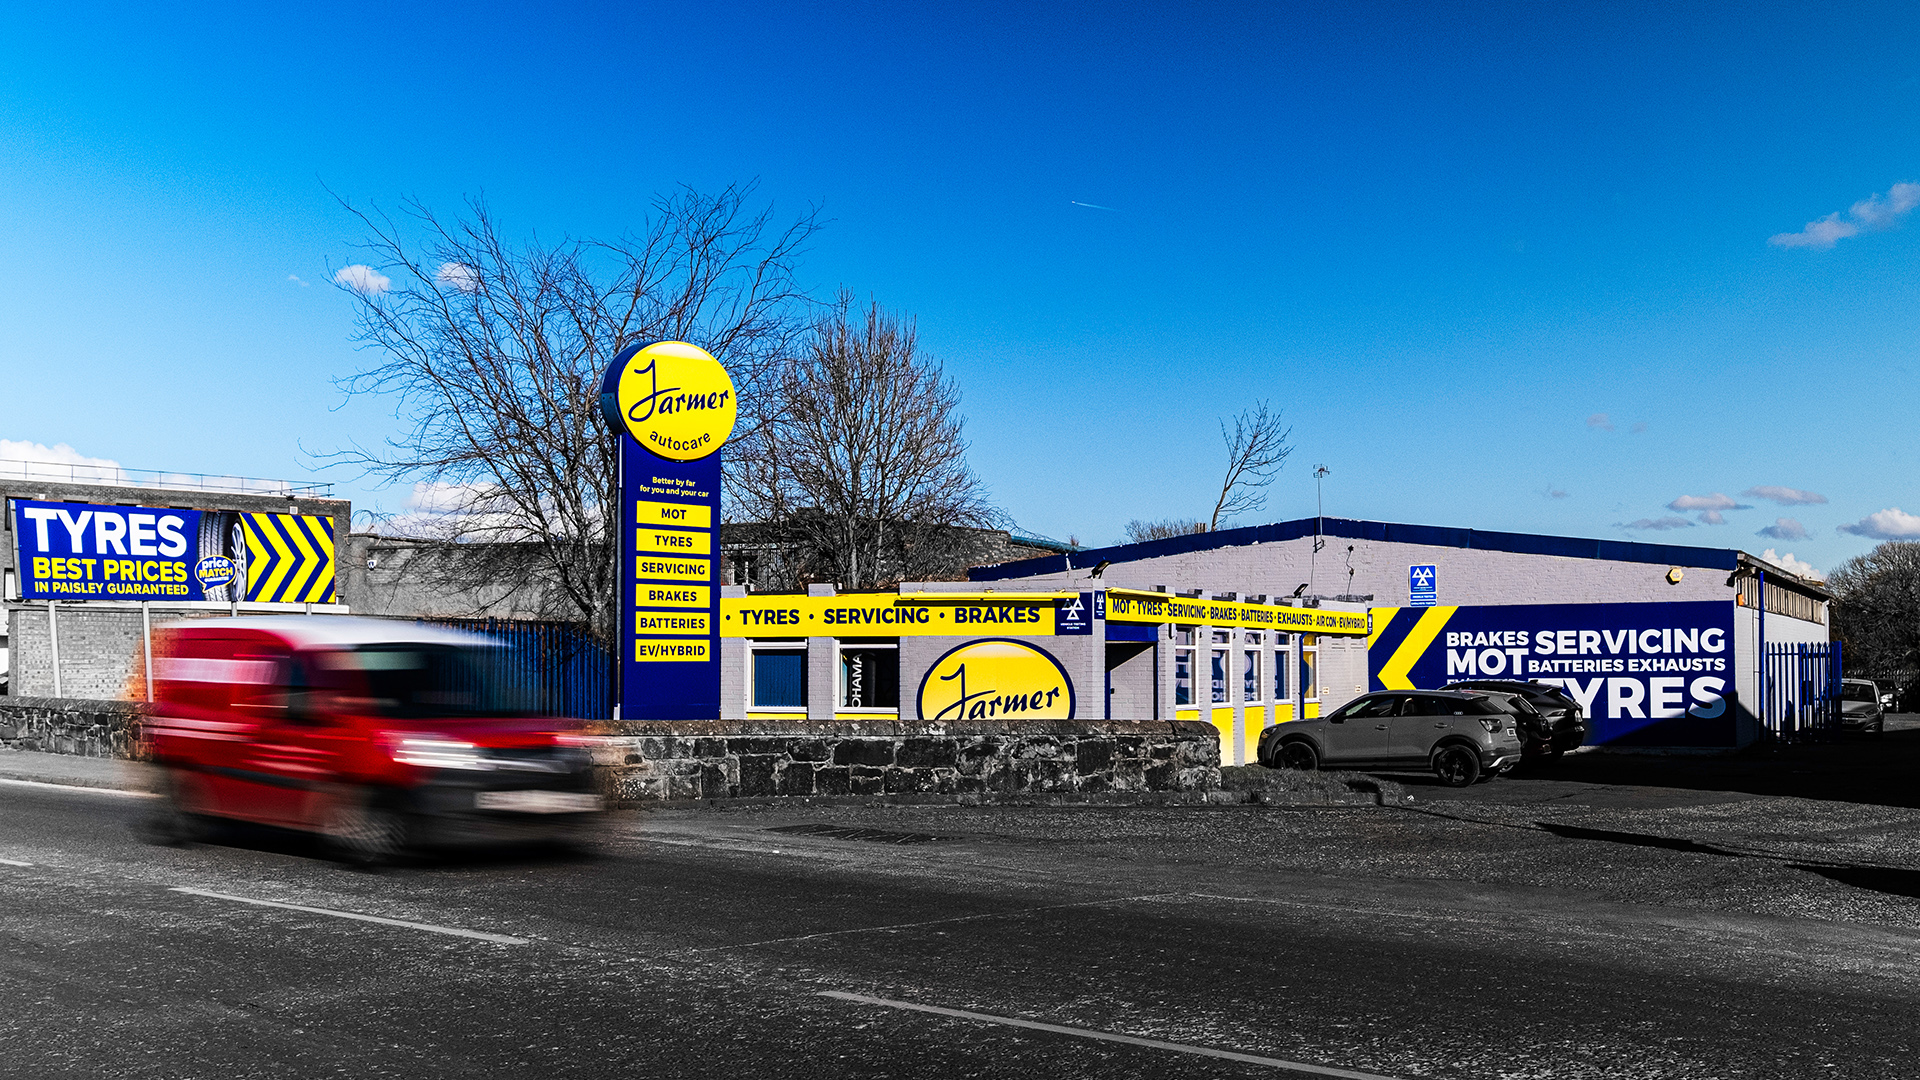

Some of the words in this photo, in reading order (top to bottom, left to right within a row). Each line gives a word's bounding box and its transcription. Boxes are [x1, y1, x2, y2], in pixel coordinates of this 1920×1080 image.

[649, 430, 711, 451] autocare
[652, 476, 674, 485] Better
[675, 478, 684, 487] by
[686, 479, 696, 487] far
[640, 484, 650, 492] for
[681, 489, 697, 497] your
[661, 508, 686, 520] MOT
[24, 507, 187, 557] TYRES
[654, 535, 693, 547] TYRES
[33, 557, 97, 580] BEST
[104, 560, 188, 582] PRICES
[202, 556, 229, 570] price
[641, 562, 705, 575] SERVICING
[199, 567, 233, 578] MATCH
[34, 582, 49, 593] IN
[52, 582, 104, 594] PAISLEY
[107, 583, 189, 596] GUARANTEED
[649, 590, 697, 602] BRAKES
[740, 609, 800, 625] TYRES
[823, 607, 930, 624] SERVICING
[954, 606, 1040, 623] BRAKES
[1113, 599, 1131, 614] MOT
[1136, 601, 1162, 616] TYRES
[1168, 603, 1206, 619] SERVICING
[1210, 606, 1237, 620] BRAKES
[1241, 608, 1273, 623] BATTERIES
[1277, 612, 1313, 626] EXHAUSTS
[1316, 615, 1325, 627] AIR
[1326, 616, 1337, 628] CON
[1339, 616, 1365, 629] EV/HYBRID
[640, 617, 705, 629] BATTERIES
[1447, 631, 1529, 647] BRAKES
[1534, 628, 1726, 655] SERVICING
[640, 644, 705, 657] EV/HYBRID
[1447, 648, 1530, 676] MOT
[1528, 659, 1625, 673] BATTERIES
[1628, 658, 1726, 672] EXHAUSTS
[1528, 676, 1726, 719] YRES
